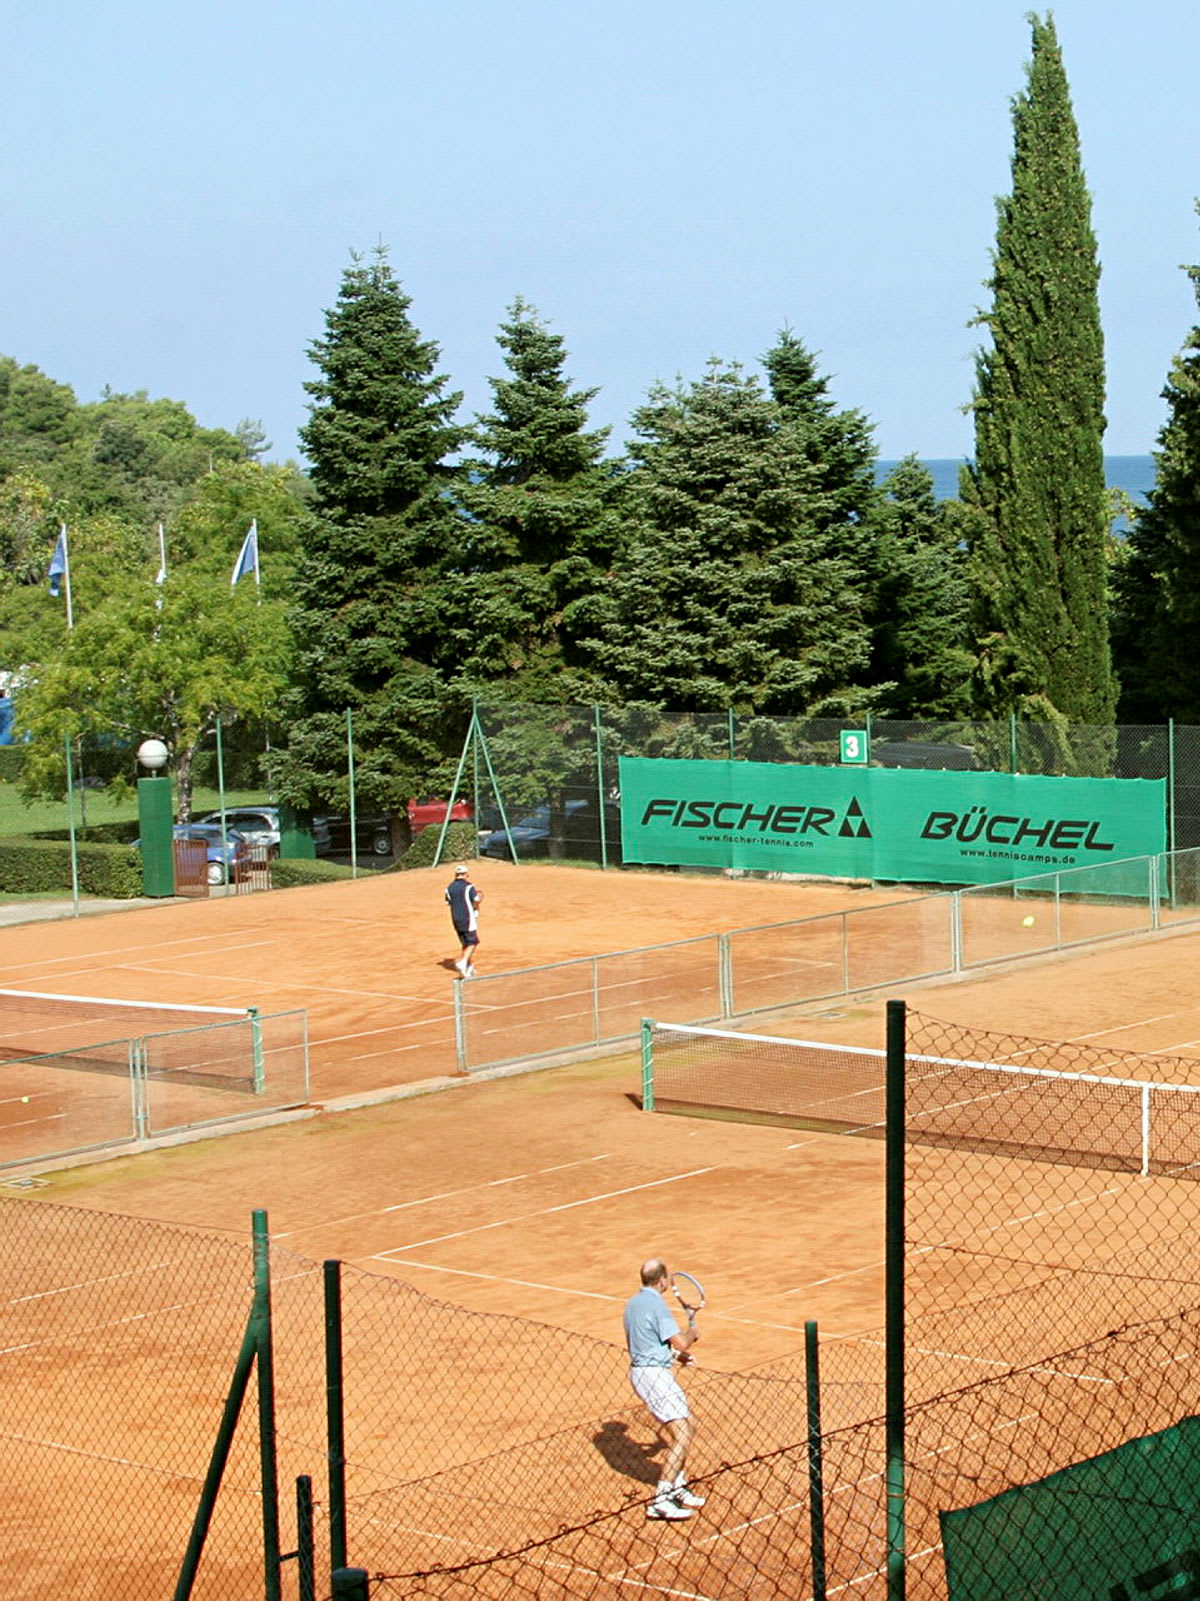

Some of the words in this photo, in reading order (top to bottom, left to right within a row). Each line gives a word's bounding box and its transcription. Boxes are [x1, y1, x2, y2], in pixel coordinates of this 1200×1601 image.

[845, 736, 859, 758] 3
[641, 799, 836, 836] FISCHER
[920, 806, 1115, 851] BÜCHEL
[698, 834, 814, 848] www.fischer-tennis.com
[960, 849, 1076, 864] www.tenniscamps.de
